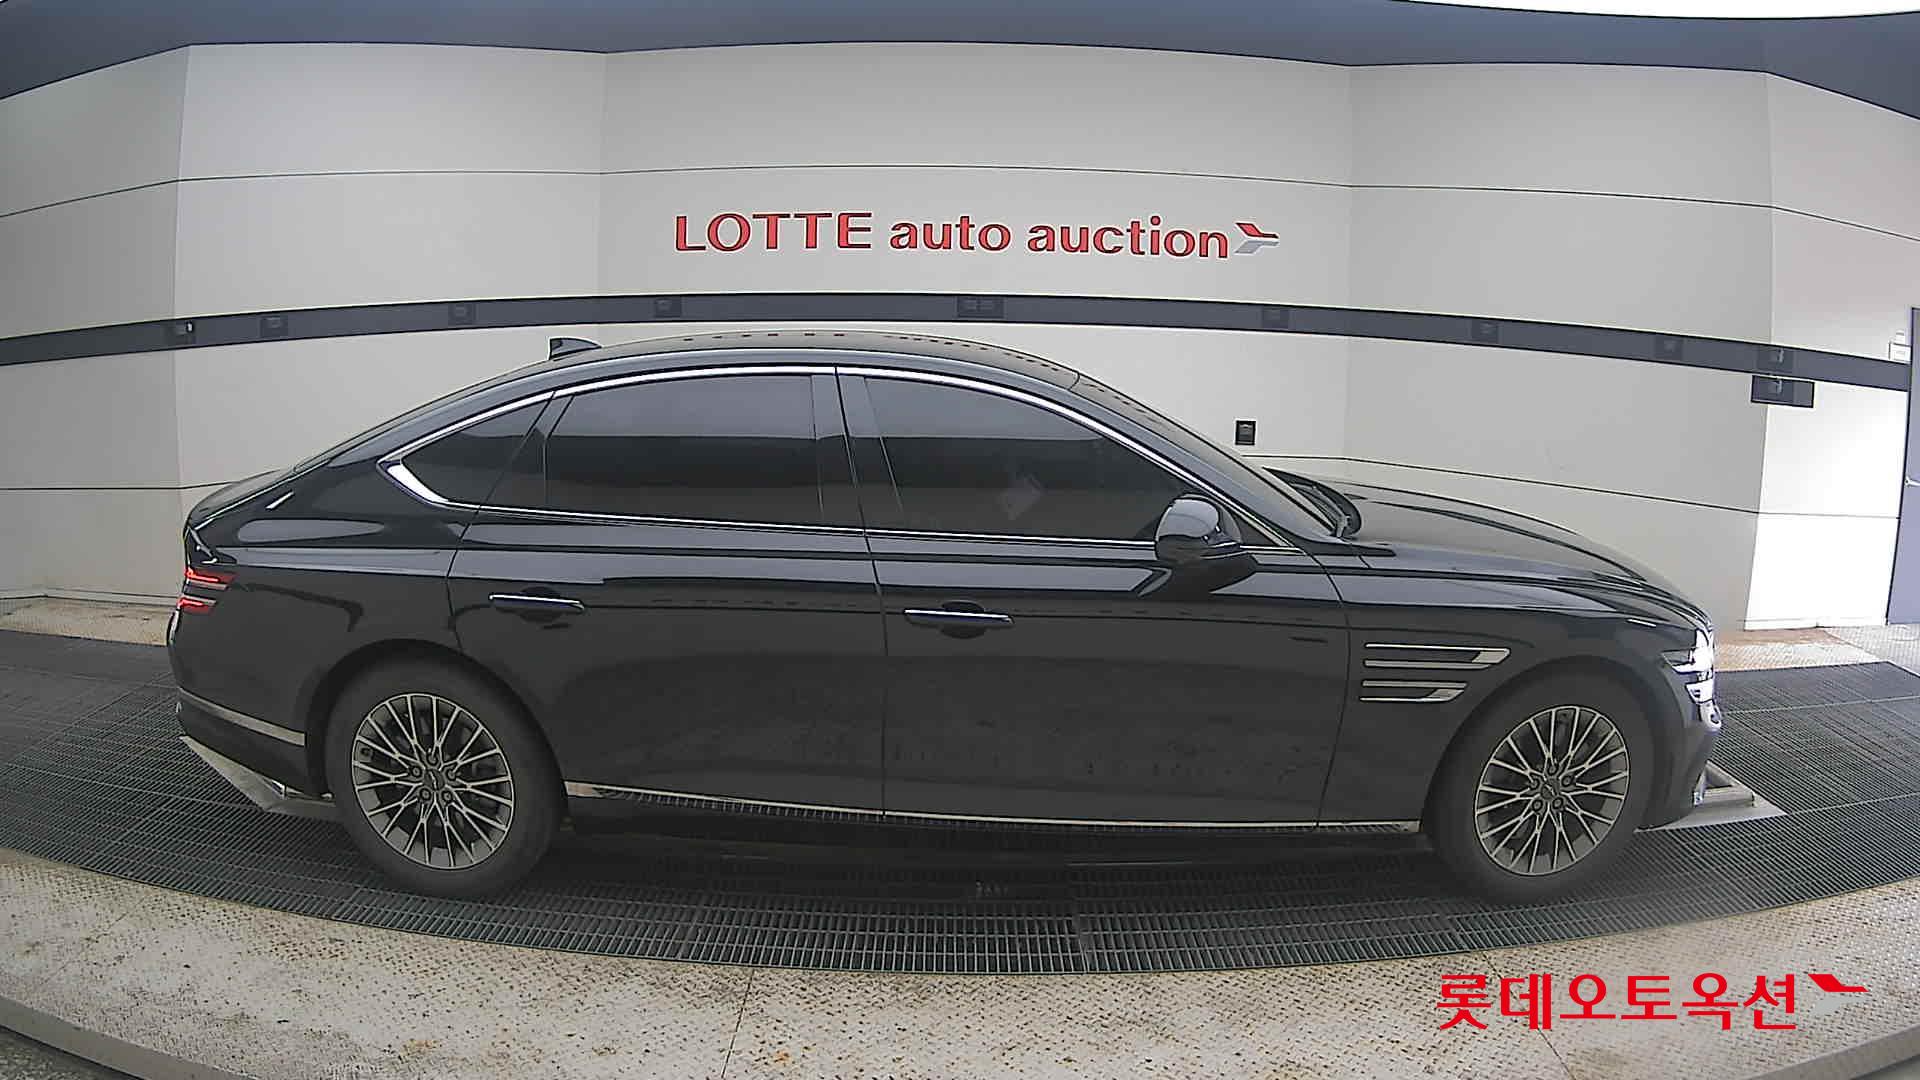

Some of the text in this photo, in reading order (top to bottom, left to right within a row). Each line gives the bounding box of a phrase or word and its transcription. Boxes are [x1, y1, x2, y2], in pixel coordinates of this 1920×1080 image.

[675, 212, 1229, 258] LOTTE auto auction
